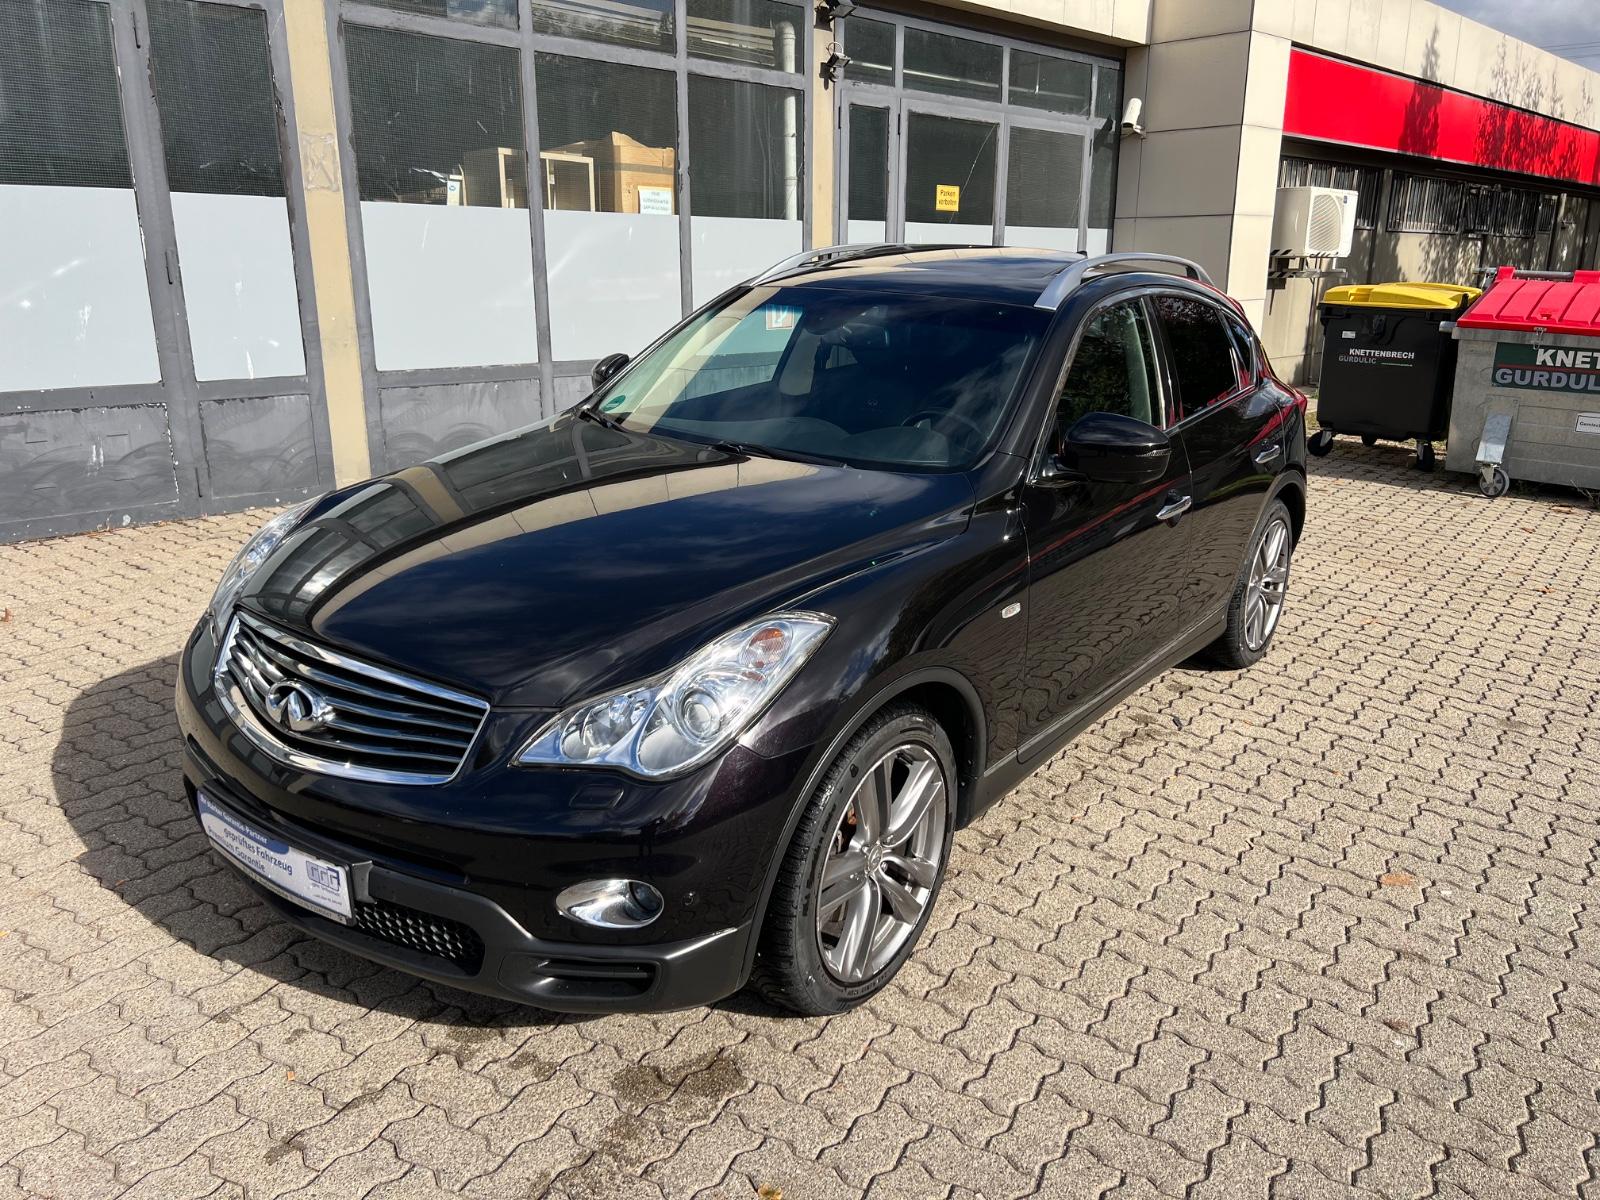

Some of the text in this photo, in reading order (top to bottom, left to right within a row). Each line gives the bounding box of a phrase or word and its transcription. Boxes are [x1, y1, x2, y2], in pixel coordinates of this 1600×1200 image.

[940, 189, 956, 197] Parken
[1338, 355, 1377, 364] GURDULIC
[1349, 348, 1415, 359] KNETTENBRECH
[1495, 368, 1600, 391] GURDUL
[235, 848, 266, 873] Garantie
[256, 847, 293, 875] Fahrzeug
